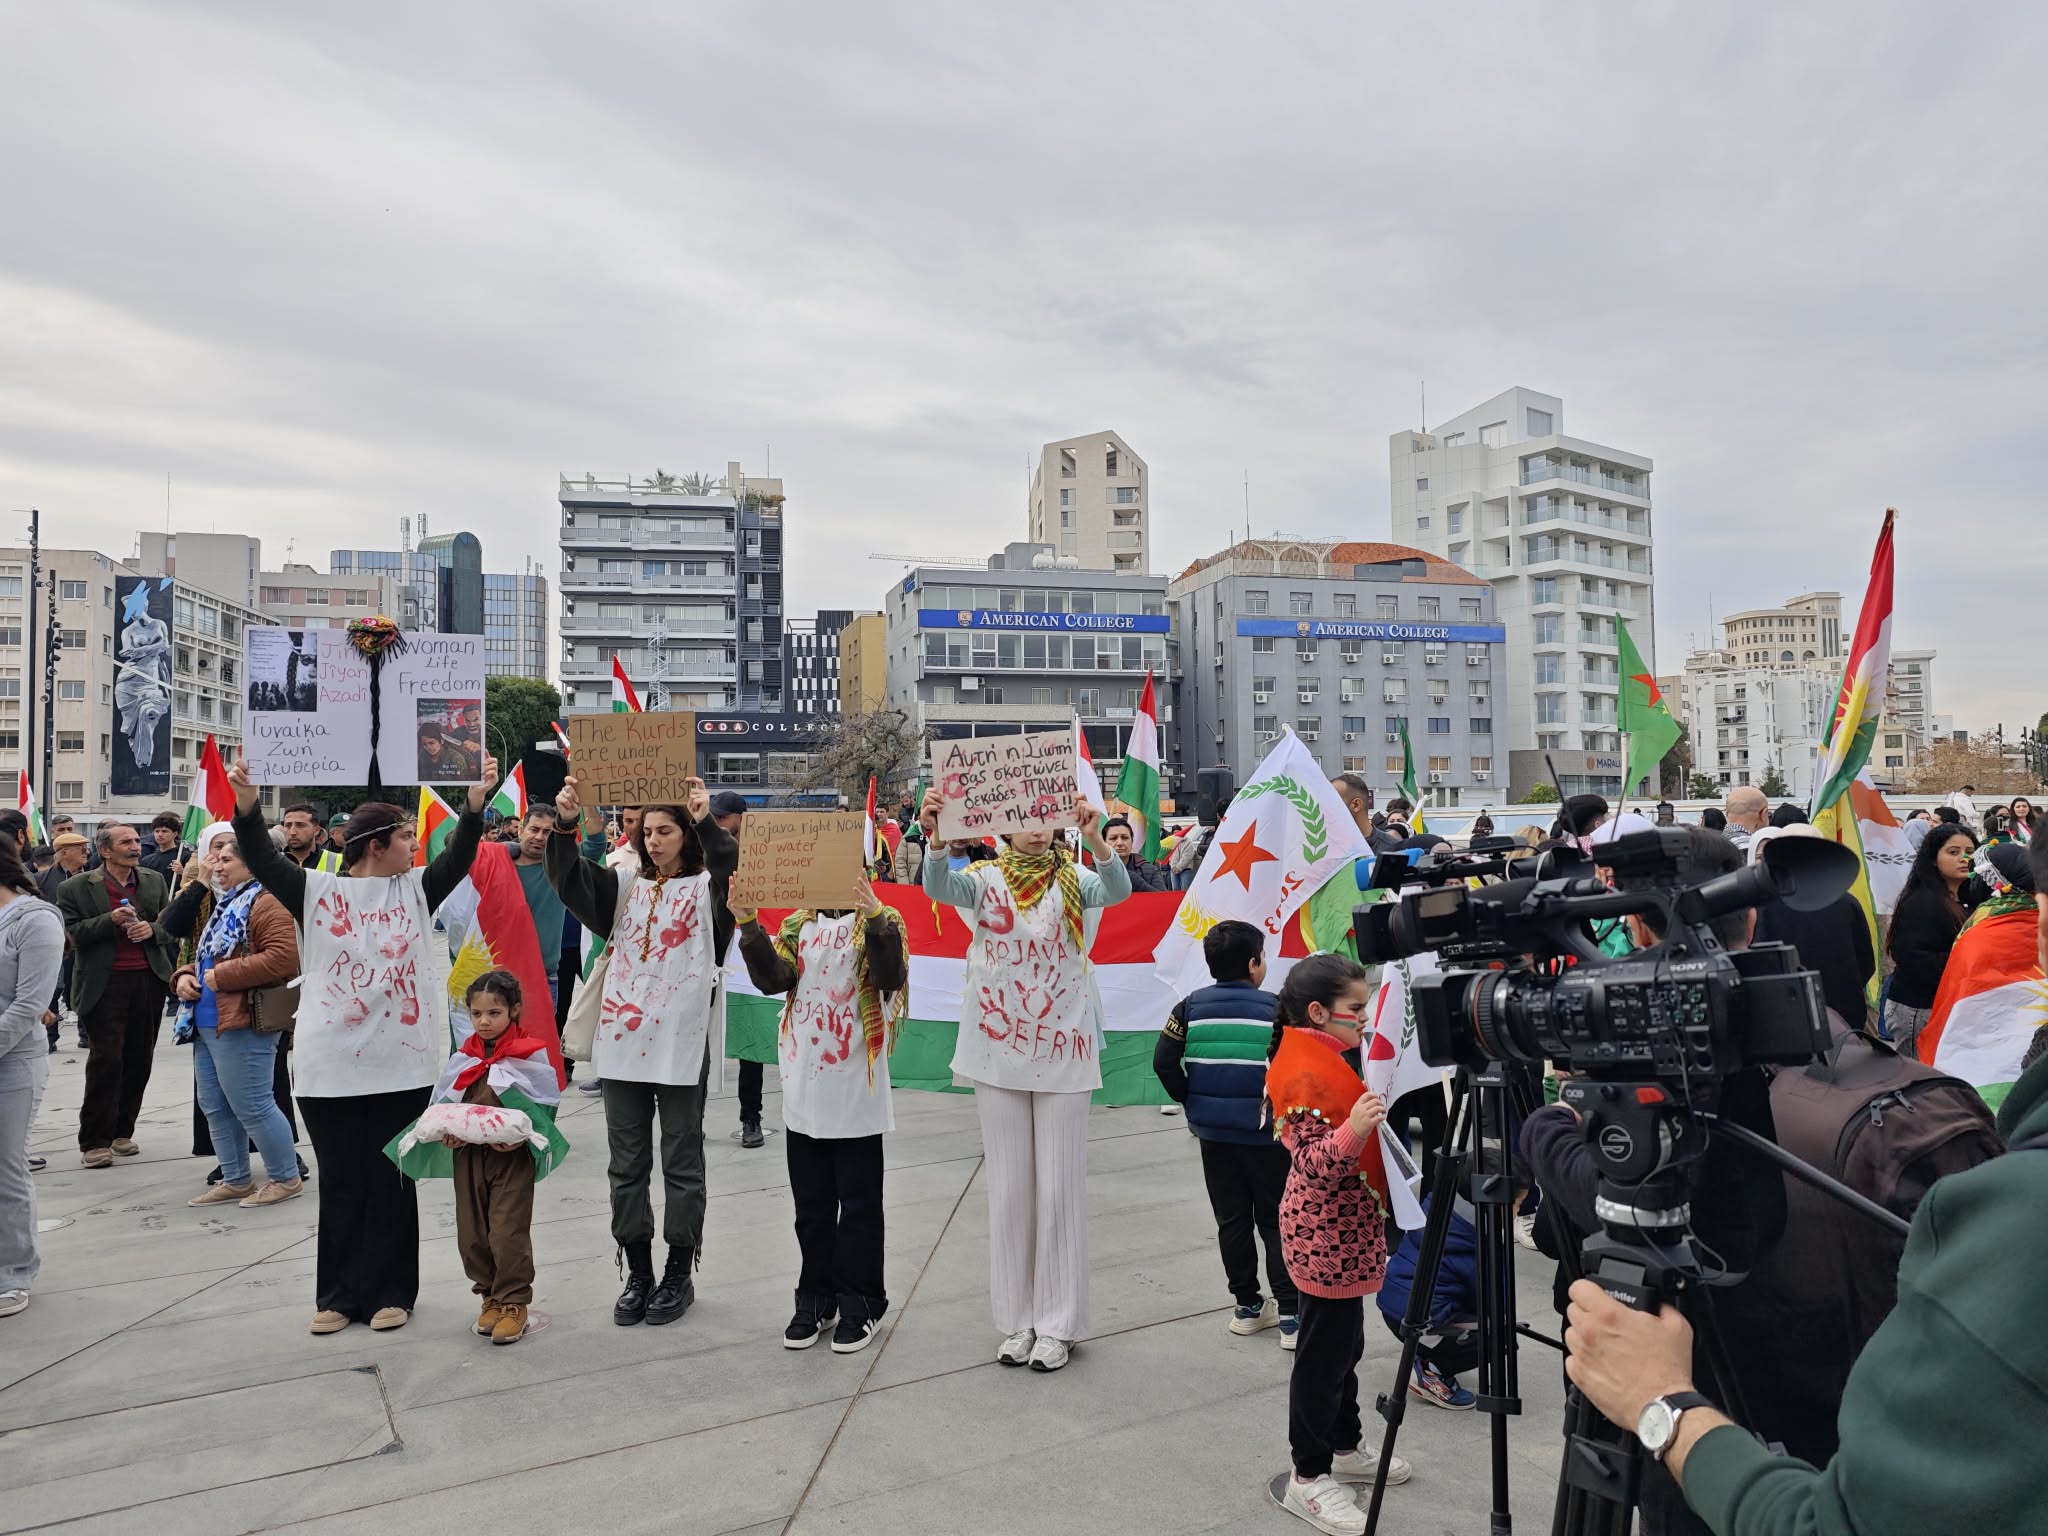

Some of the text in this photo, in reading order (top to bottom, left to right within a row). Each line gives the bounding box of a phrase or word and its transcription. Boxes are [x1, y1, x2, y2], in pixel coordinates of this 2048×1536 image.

[980, 611, 1059, 627] AMERICAN
[1065, 613, 1135, 628] COLLEGE
[1316, 622, 1384, 637] AMERICAN
[1389, 624, 1449, 638] COLLEGE
[424, 655, 459, 669] Life
[399, 671, 481, 696] Freedom
[253, 716, 331, 738] Γυναίκα
[572, 715, 687, 743] The Kurds
[267, 739, 312, 757] Ζωή
[574, 743, 663, 761] are under
[946, 736, 1072, 768] Αυτή η Σιωπή
[575, 757, 688, 781] attack by
[959, 760, 1069, 786] σας σκοτώνει
[964, 775, 1078, 809] δεκάδες ΠΑΙΔΙΑ
[745, 814, 863, 843] Rojava right NOW
[963, 812, 993, 827] την
[749, 840, 816, 857] NO water
[748, 856, 815, 871] NO power
[747, 872, 800, 888] NO fuel
[745, 885, 805, 903] NO food
[985, 939, 1068, 965] ROJAVA
[328, 950, 416, 988] ROJAVA
[1670, 962, 1707, 971] SONY
[795, 999, 854, 1025] OJAVA
